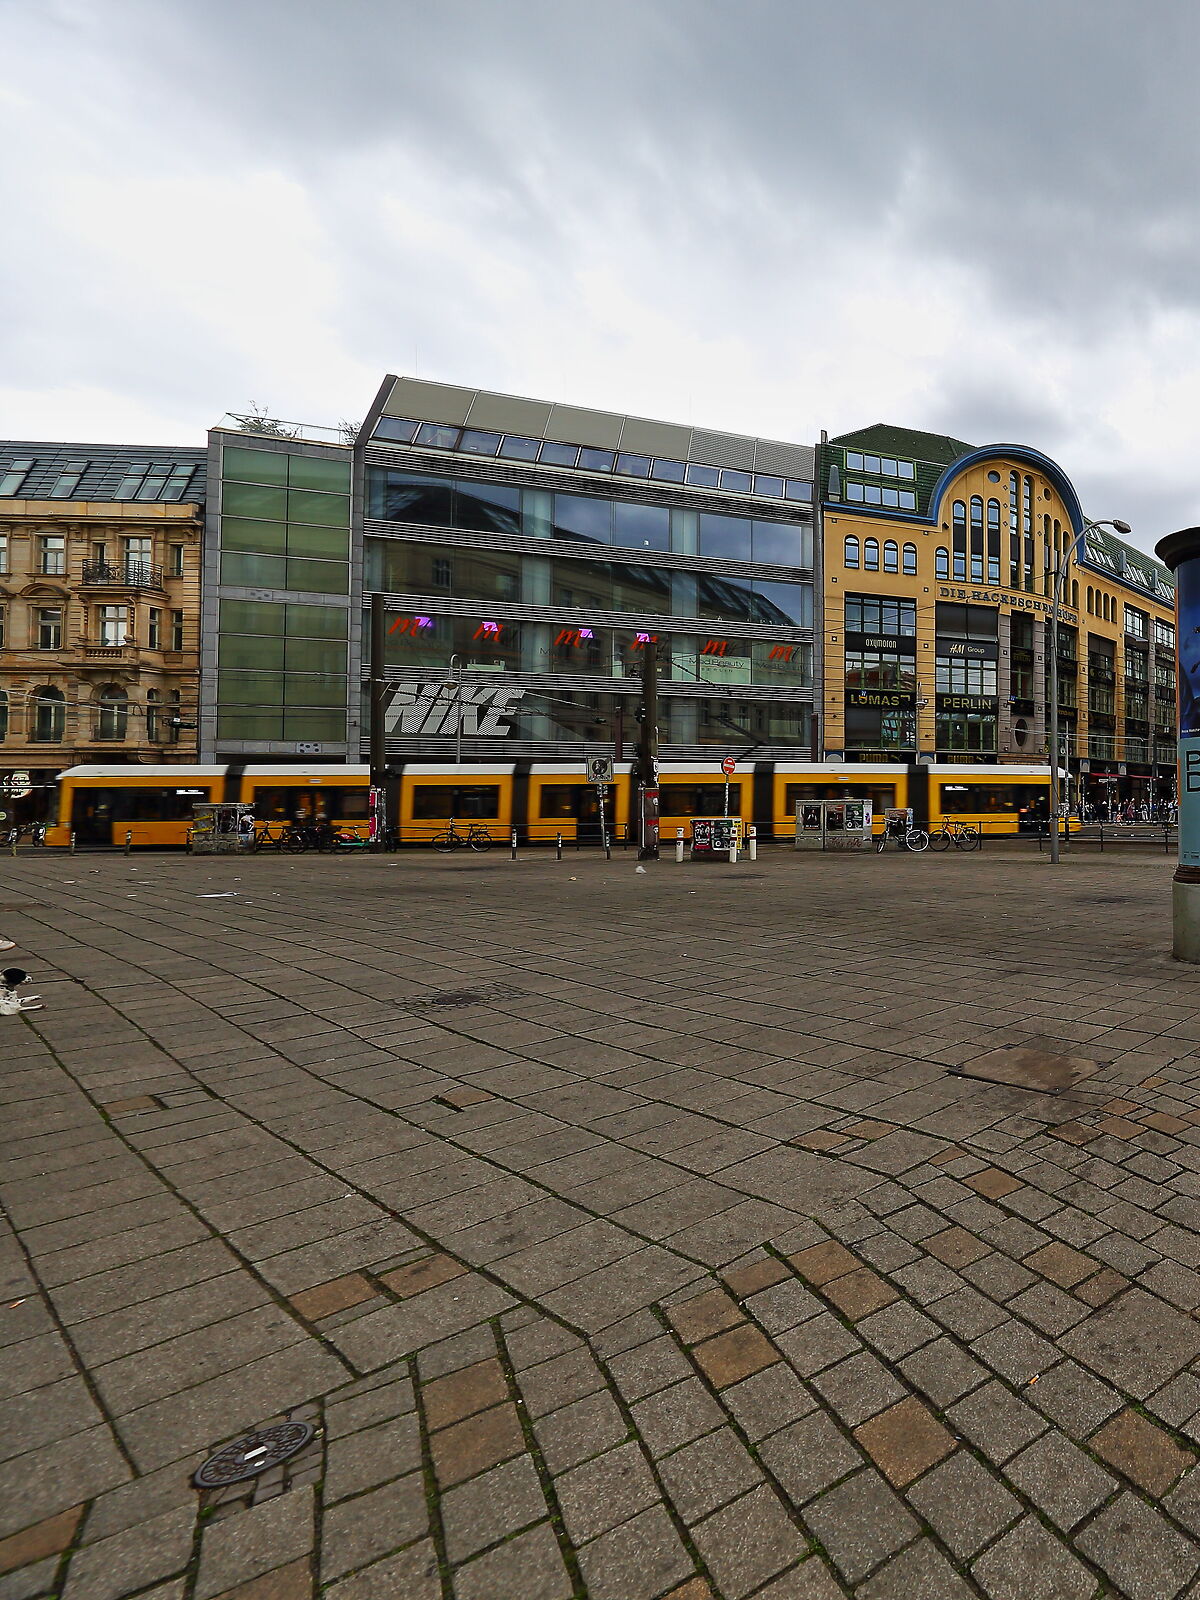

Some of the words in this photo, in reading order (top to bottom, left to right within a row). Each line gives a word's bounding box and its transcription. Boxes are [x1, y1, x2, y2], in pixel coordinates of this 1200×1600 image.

[940, 587, 966, 600] DIE
[865, 638, 897, 649] oxymoron
[967, 646, 985, 654] Group
[385, 684, 526, 736] NIKE
[943, 697, 992, 710] PERLIN
